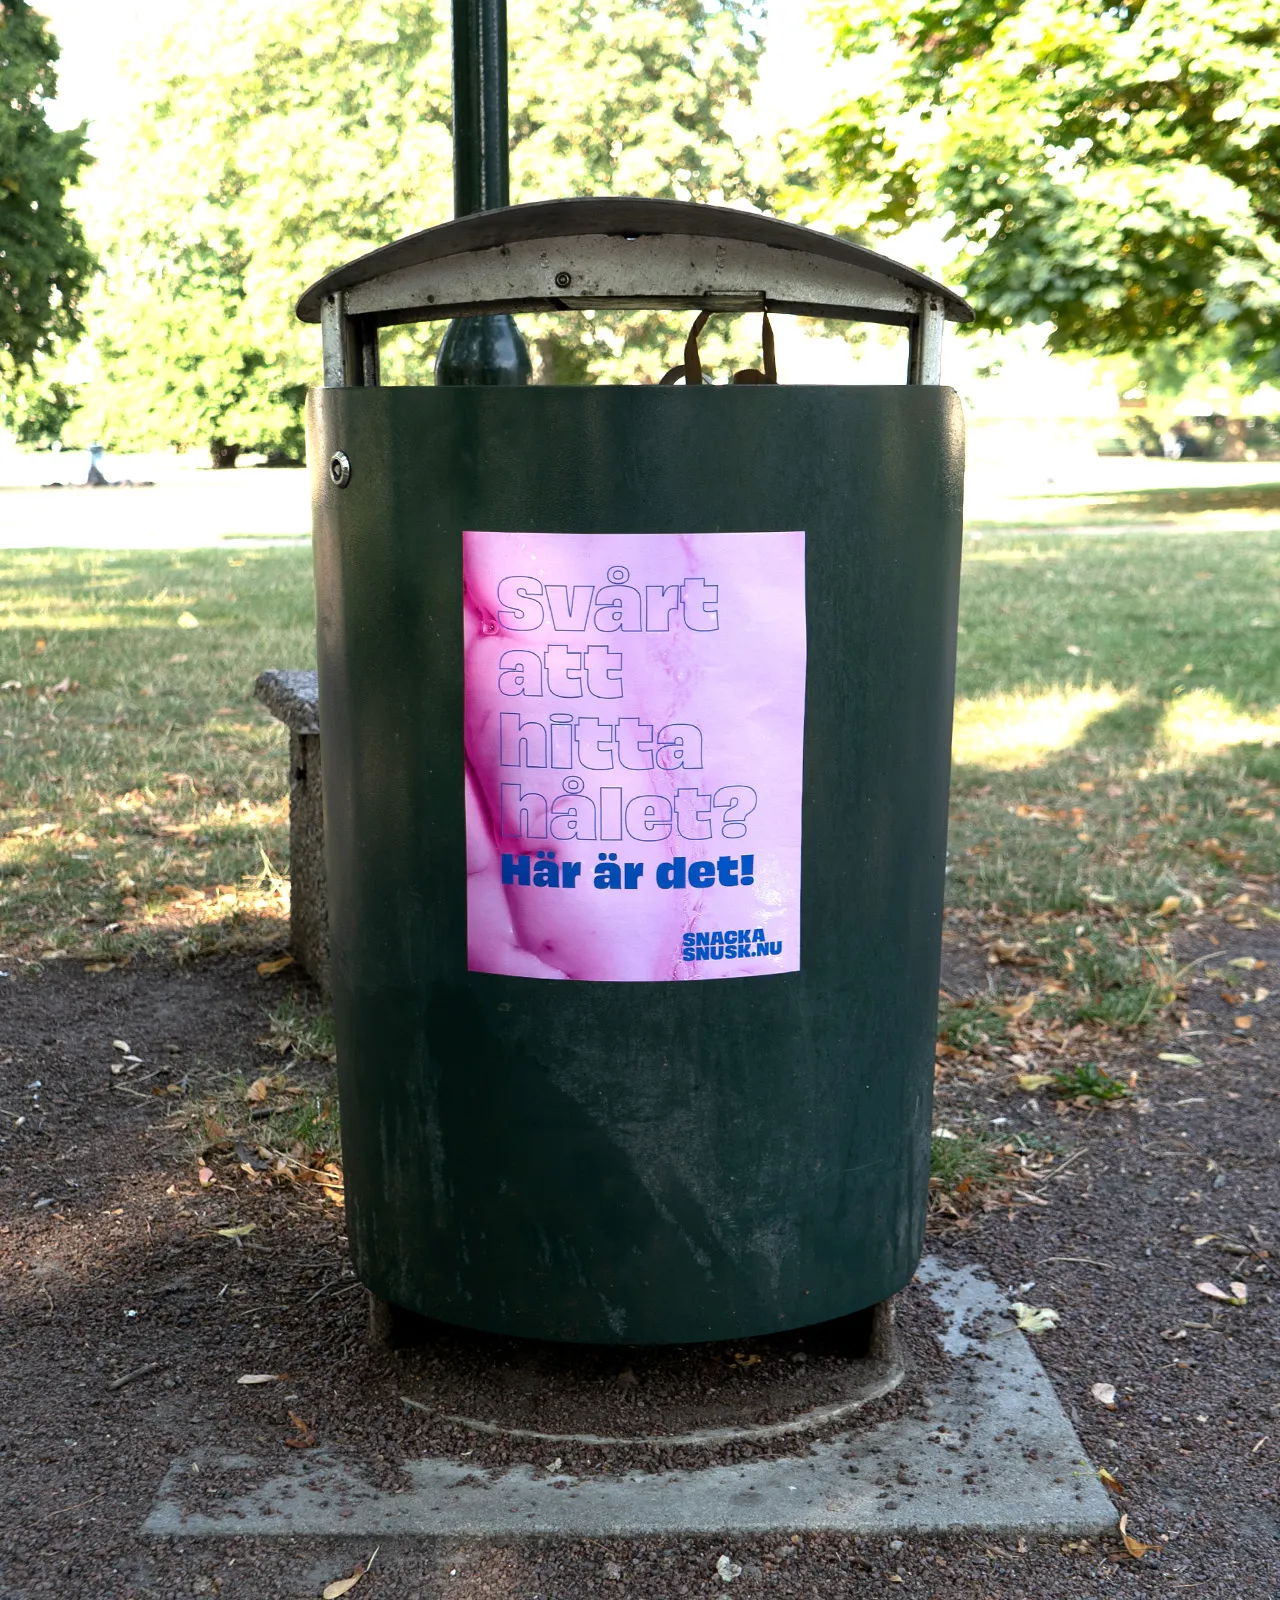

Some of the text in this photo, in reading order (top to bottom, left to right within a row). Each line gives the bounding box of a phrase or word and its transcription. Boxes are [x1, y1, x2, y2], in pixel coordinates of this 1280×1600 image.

[497, 565, 719, 632] Svårt
[498, 644, 624, 699] att
[499, 712, 704, 770] hitta
[500, 776, 758, 842] hålet?
[501, 851, 755, 889] Här är det!
[682, 928, 766, 947] SNACKA
[682, 941, 783, 961] SNUSK.NU
